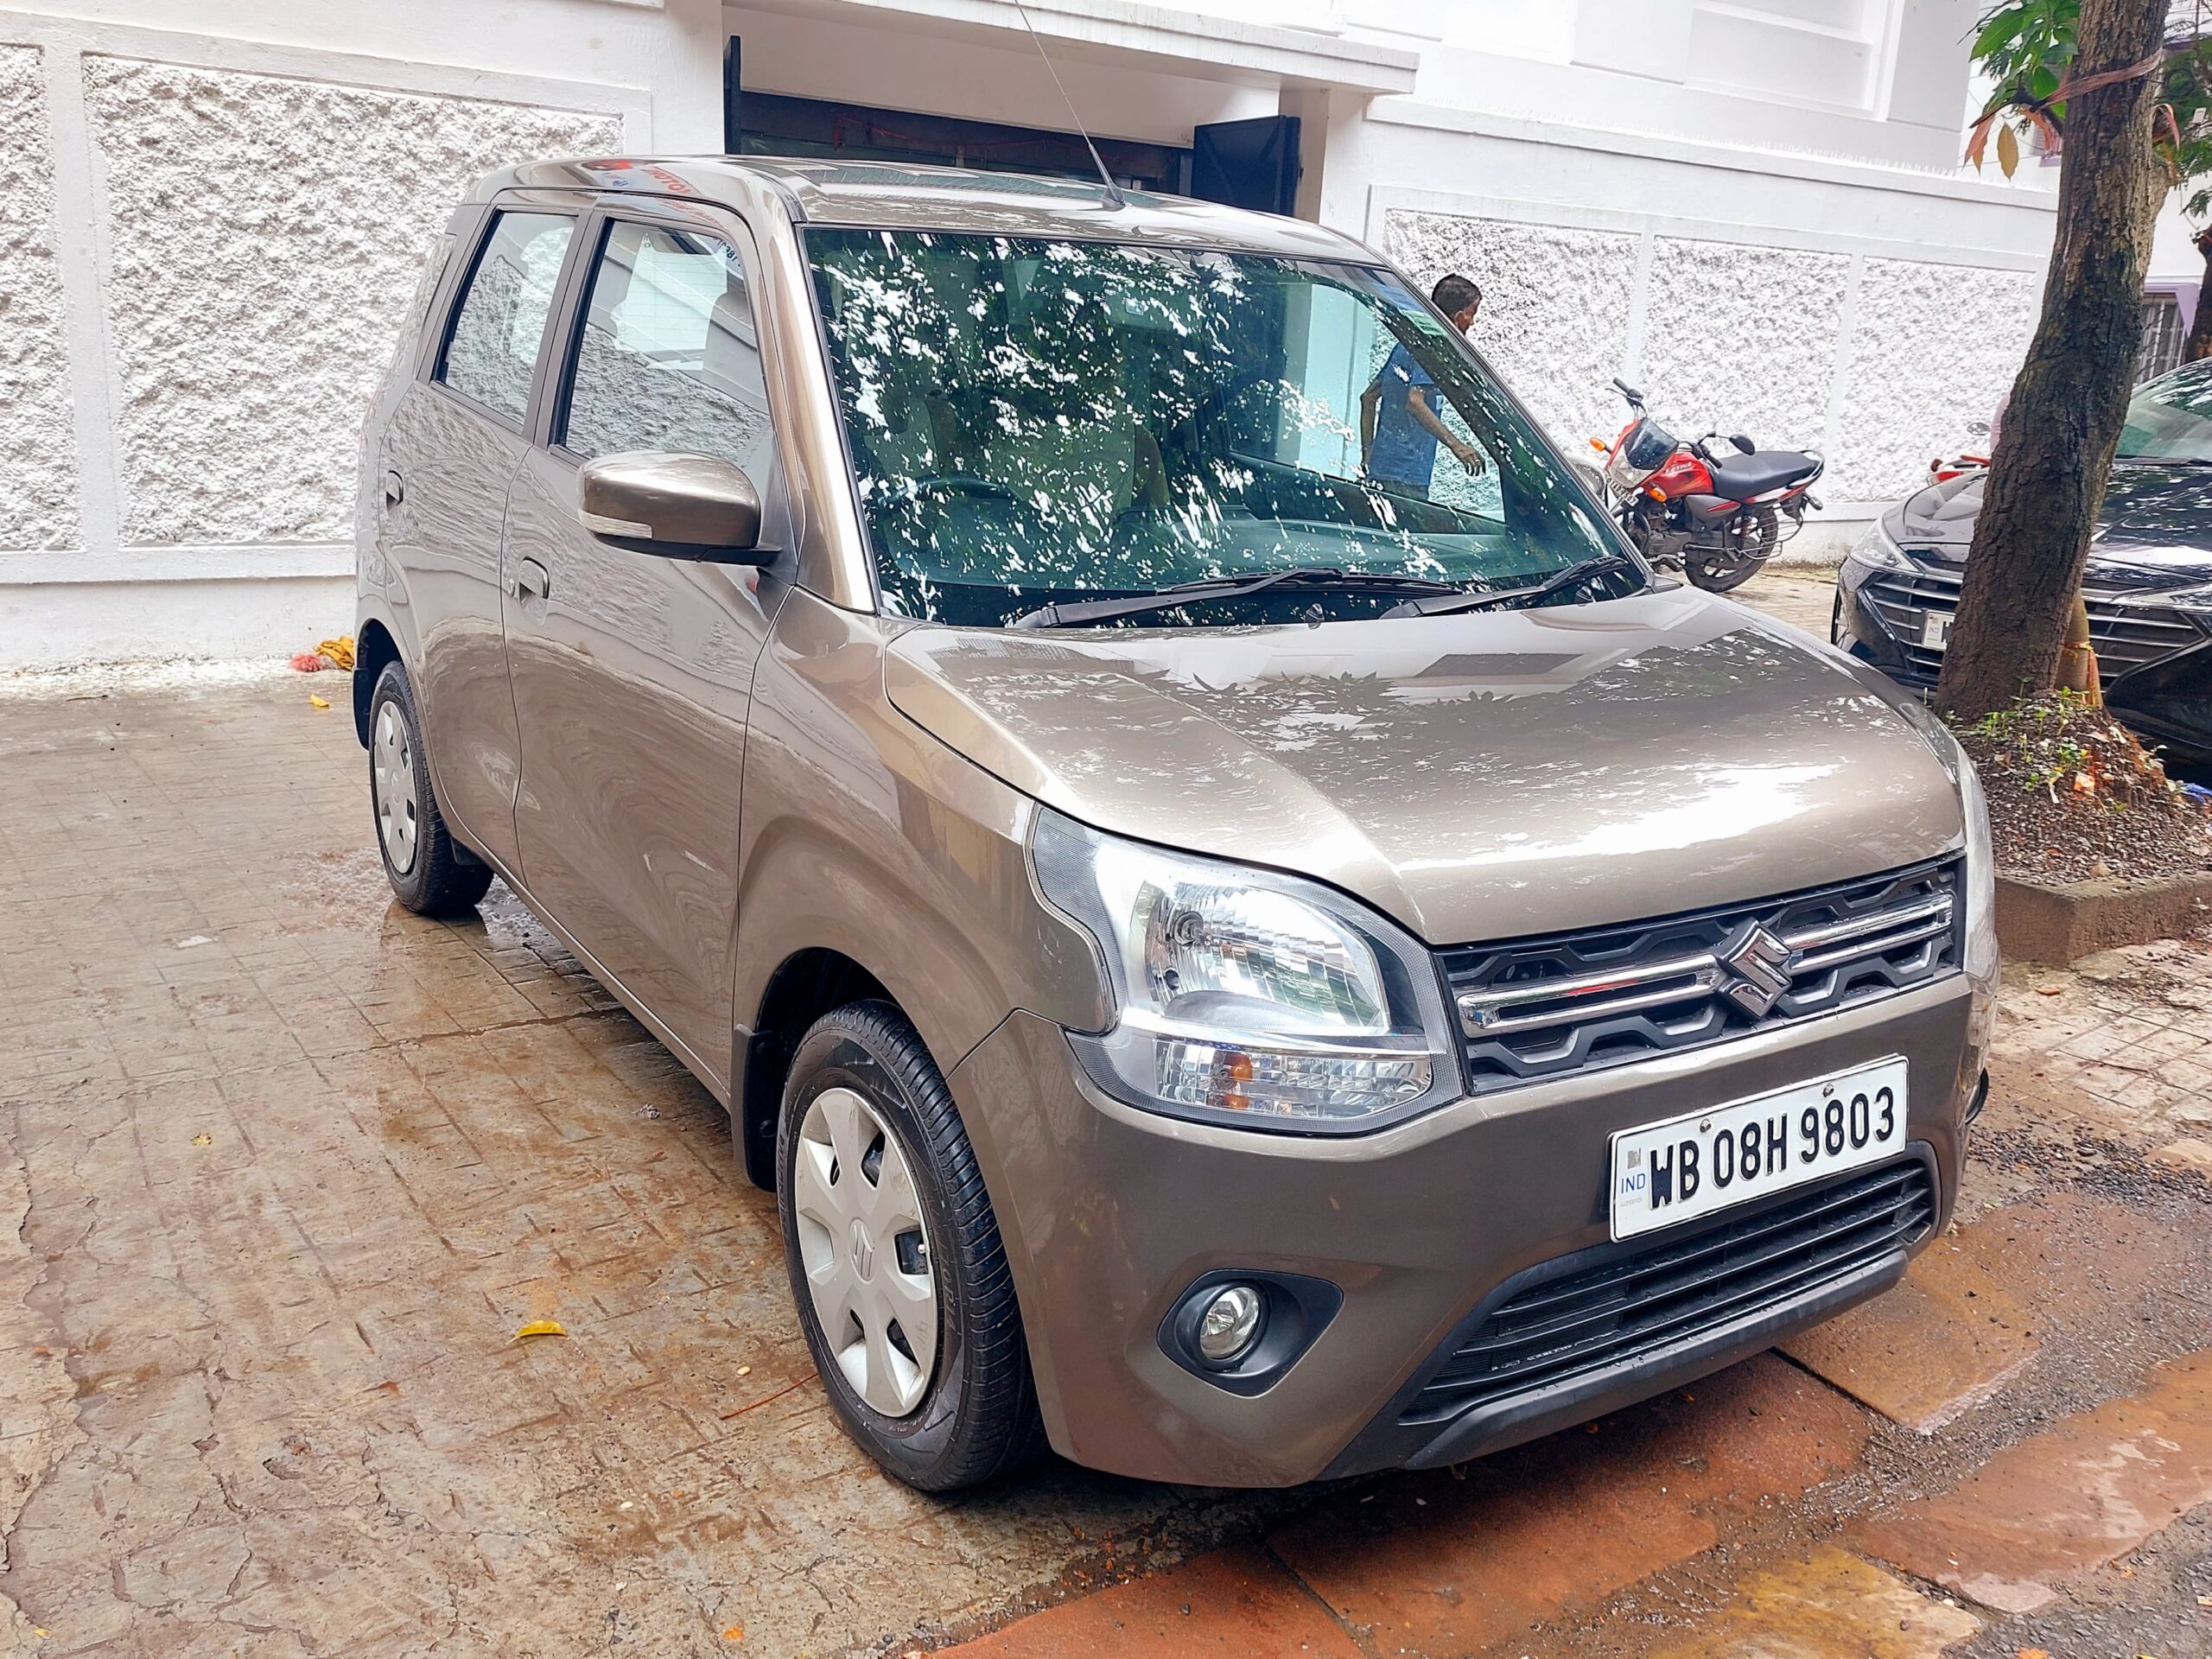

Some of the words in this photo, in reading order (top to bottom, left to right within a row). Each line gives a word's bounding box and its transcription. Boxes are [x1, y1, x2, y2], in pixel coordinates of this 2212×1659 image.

[1621, 1173, 1645, 1194] IND
[1649, 1140, 1700, 1210] WB
[1713, 1113, 1787, 1189] 08H
[1800, 1086, 1894, 1164] 9803
